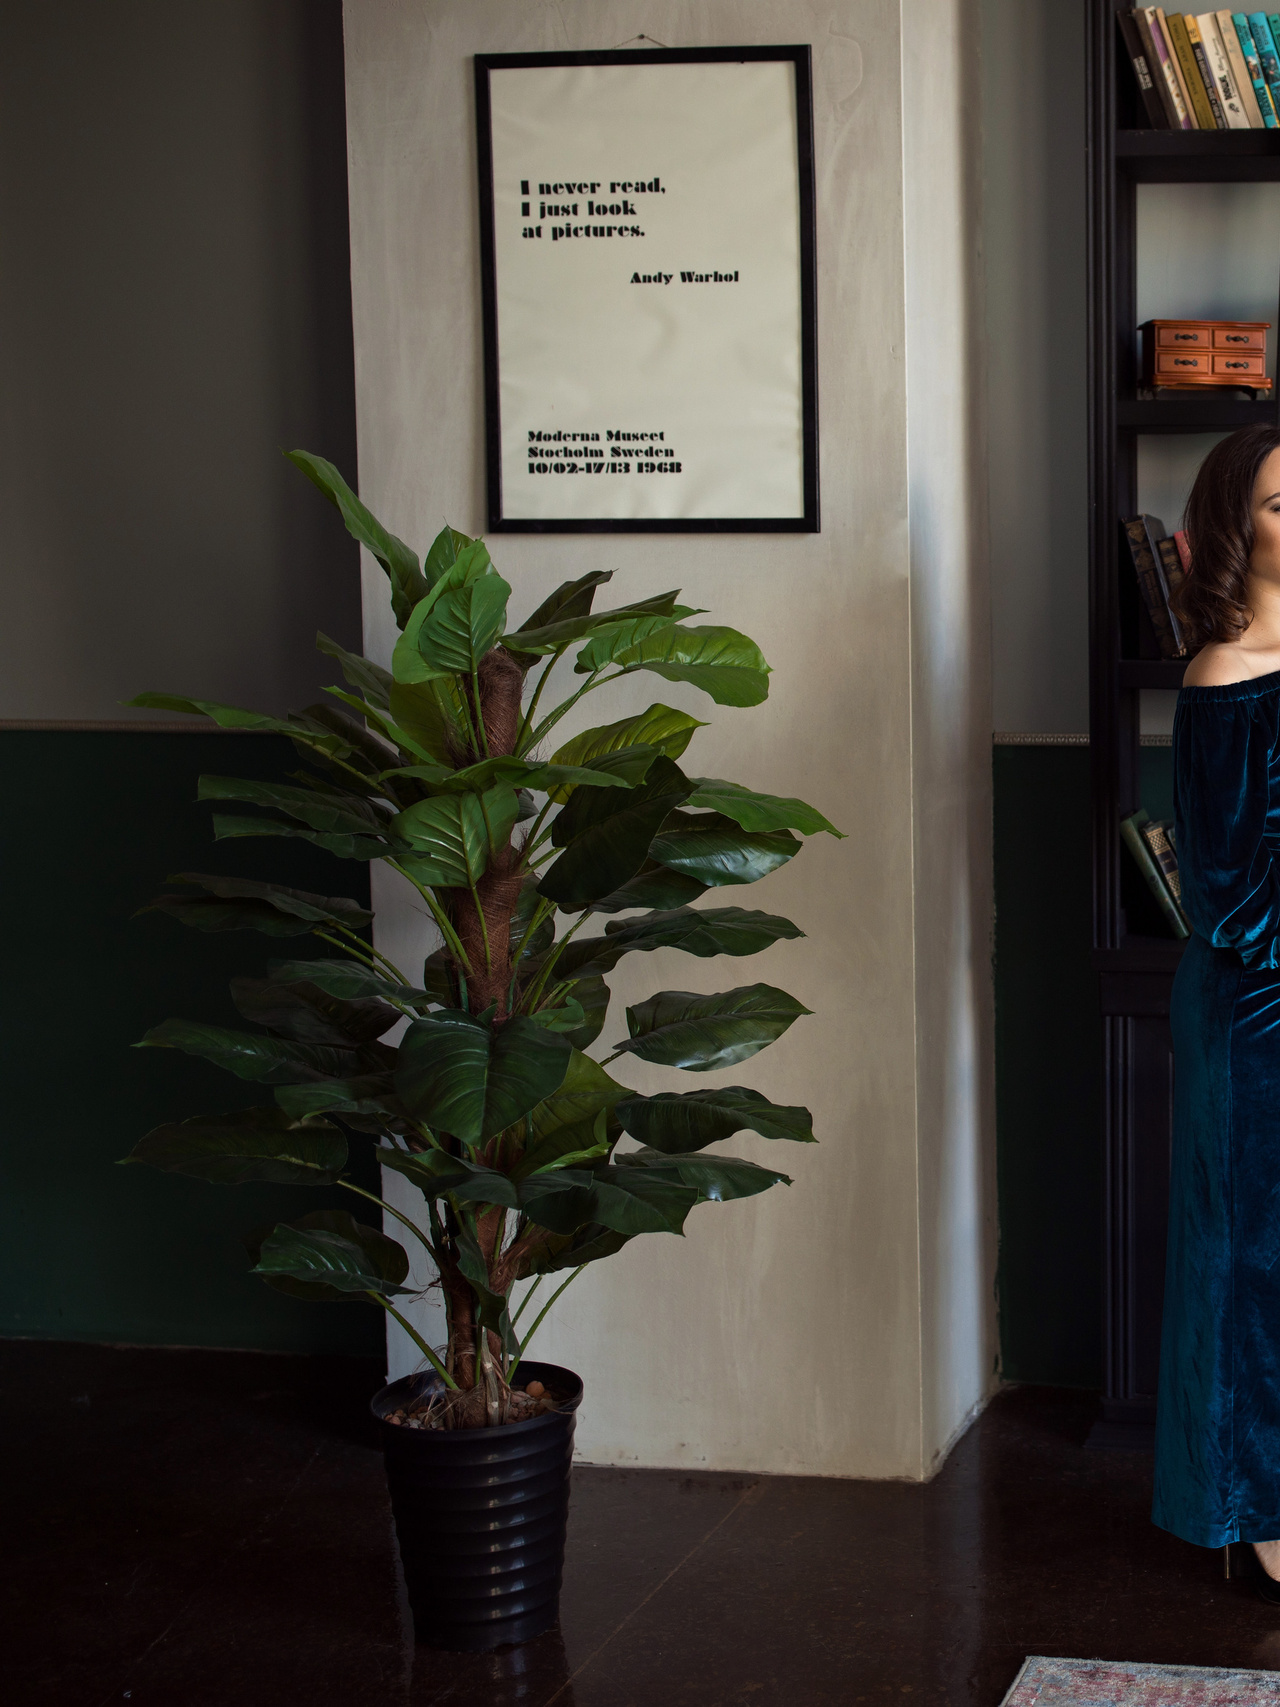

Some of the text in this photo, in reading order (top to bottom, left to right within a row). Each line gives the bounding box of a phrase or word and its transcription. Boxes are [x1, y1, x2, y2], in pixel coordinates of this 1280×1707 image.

[521, 177, 666, 196] I never read,
[521, 199, 637, 220] I just look
[521, 222, 646, 241] at pictures.
[630, 270, 739, 286] Andy Warhol
[528, 429, 665, 442] Moderna Museet
[527, 446, 675, 458] Stocholm Sweden
[637, 461, 682, 474] 1968
